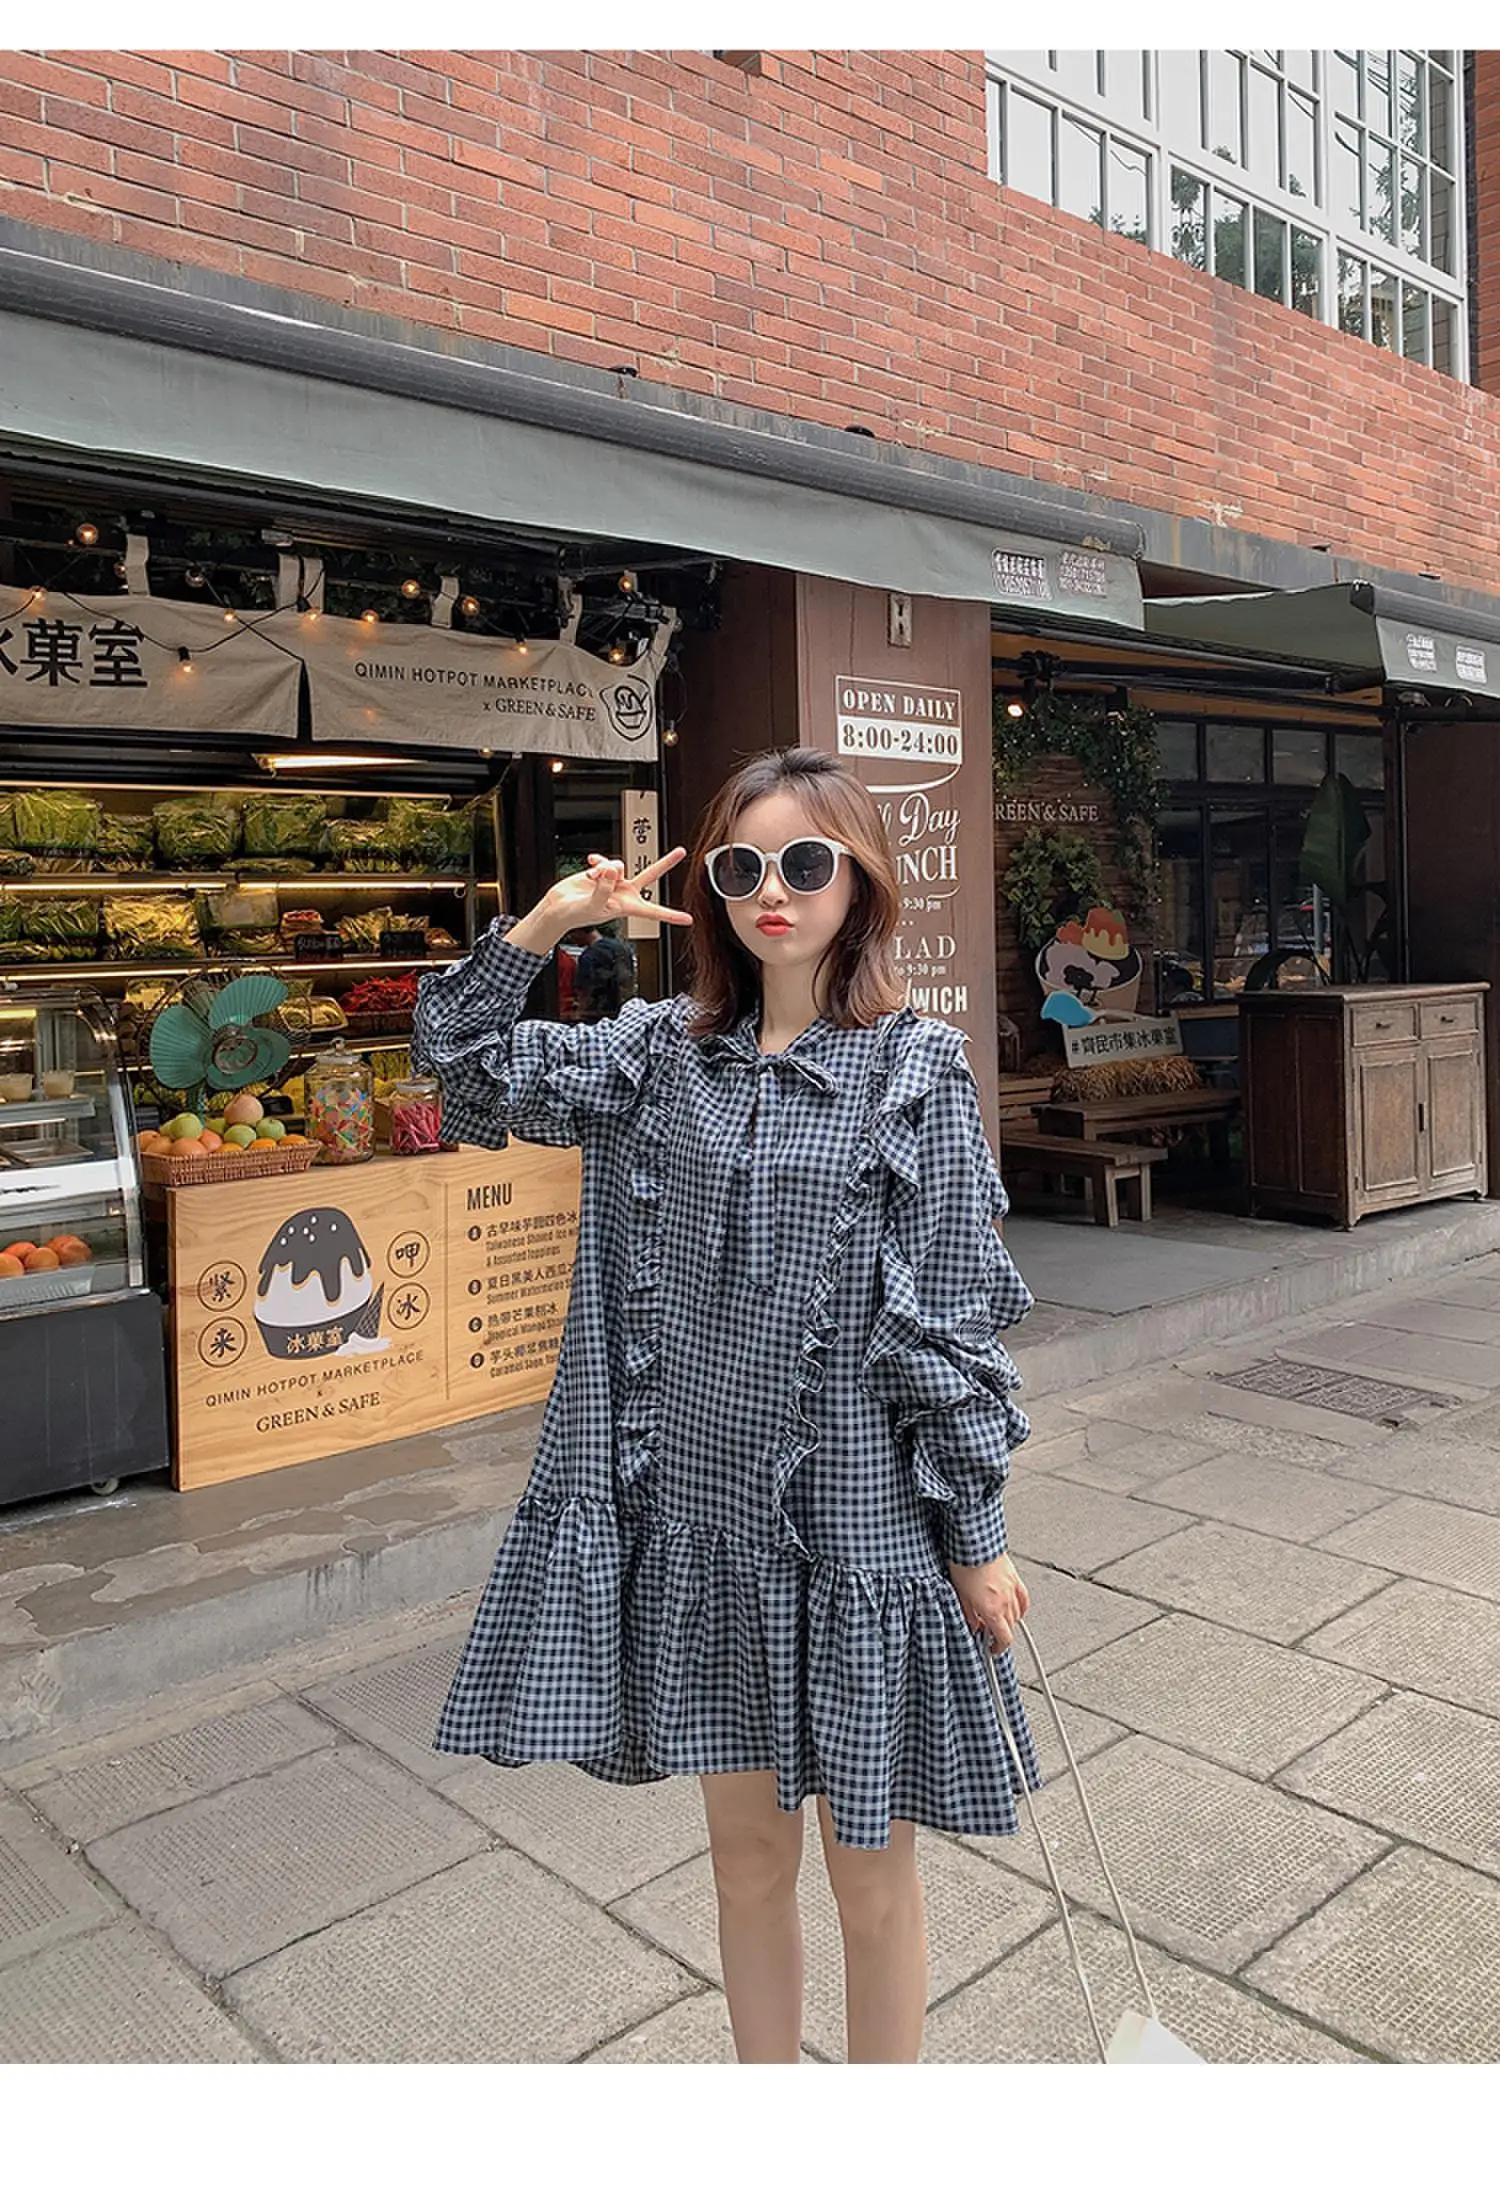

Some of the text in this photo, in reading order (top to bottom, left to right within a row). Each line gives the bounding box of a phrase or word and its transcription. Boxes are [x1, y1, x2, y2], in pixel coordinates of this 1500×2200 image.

[355, 662, 405, 680] QIMIN
[411, 667, 478, 687] HOTPOT
[843, 689, 955, 720] OPEN DAILY
[843, 724, 958, 756] 8:00-24:00
[898, 792, 960, 847] Day
[896, 845, 959, 885] NCH
[895, 935, 956, 960] LAD
[911, 986, 968, 1015] WICH
[467, 1183, 513, 1211] MENU
[396, 1293, 421, 1321] 冰
[206, 1349, 424, 1408] QIMIN HOTPOT MARKETPLACE
